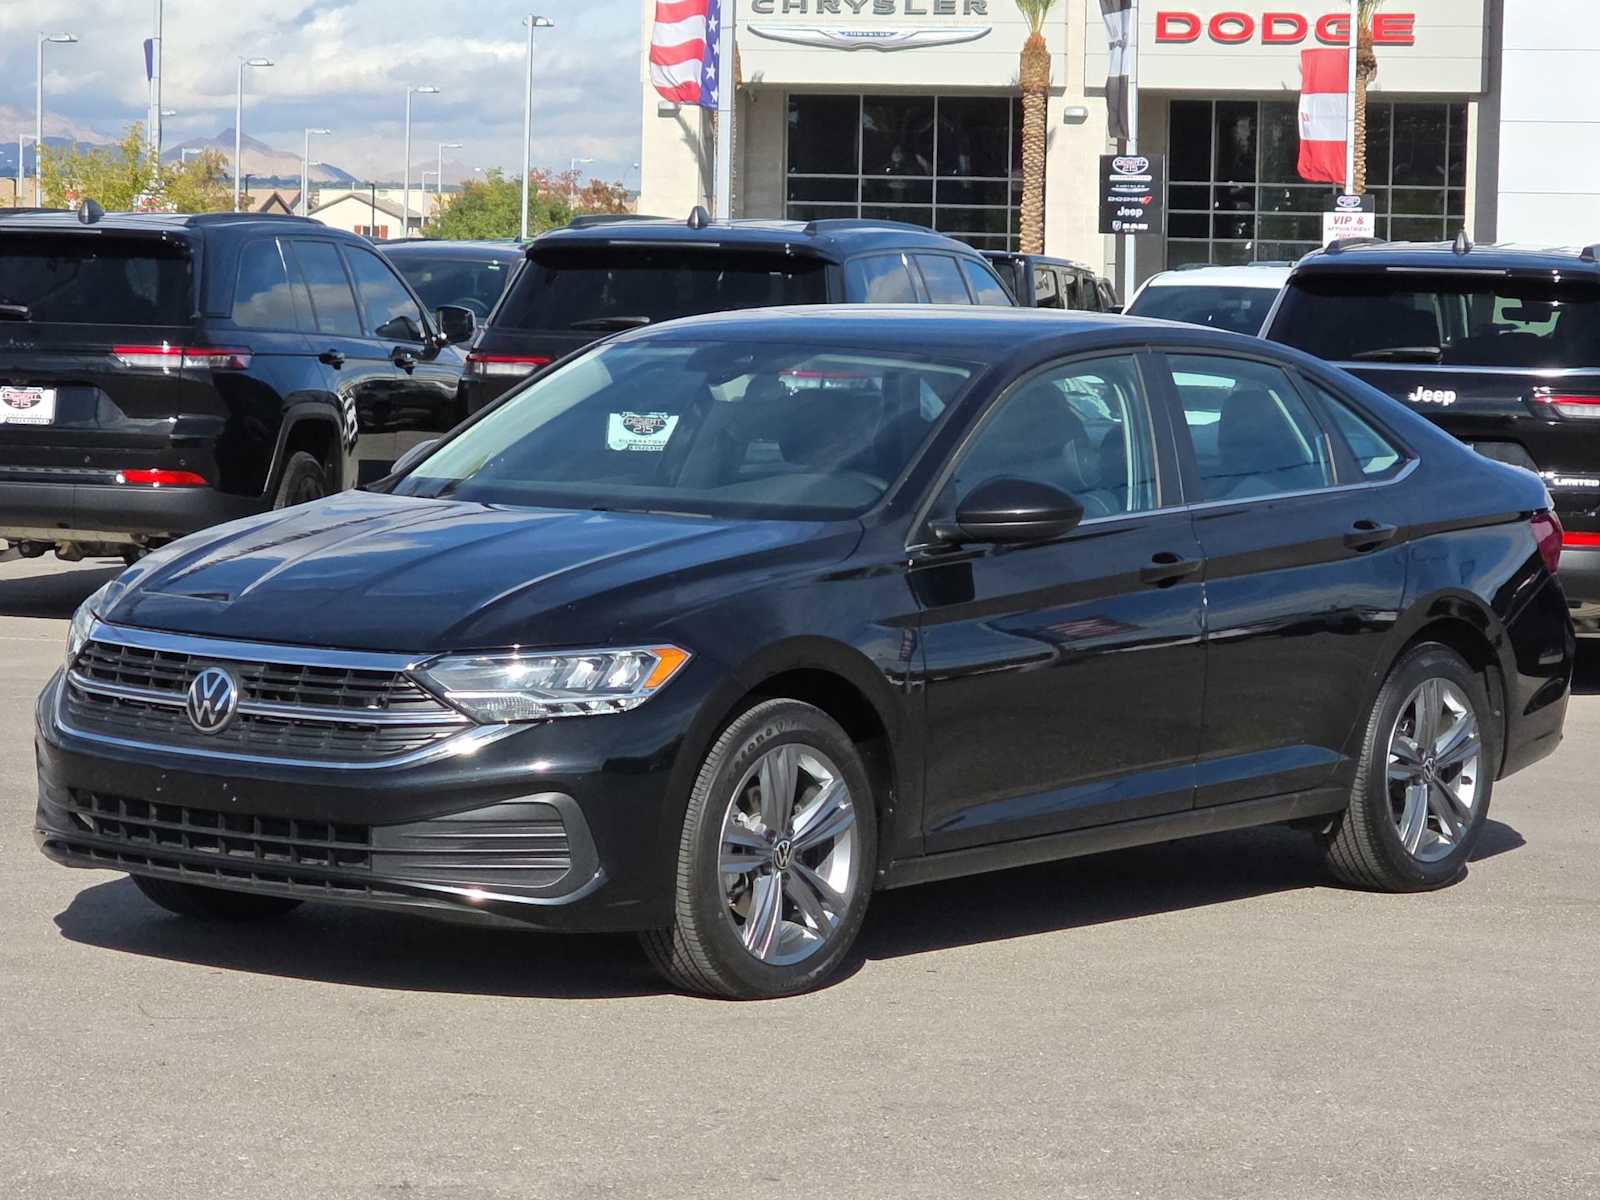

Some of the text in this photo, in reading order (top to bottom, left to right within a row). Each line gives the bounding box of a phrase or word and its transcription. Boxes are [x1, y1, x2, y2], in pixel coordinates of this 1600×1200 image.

[751, 0, 988, 15] CHRYSLER
[1155, 11, 1416, 46] DODGE
[1117, 206, 1143, 218] Jeep
[1334, 215, 1365, 225] VIP &
[1409, 386, 1457, 406] Jeep
[633, 425, 654, 434] 215
